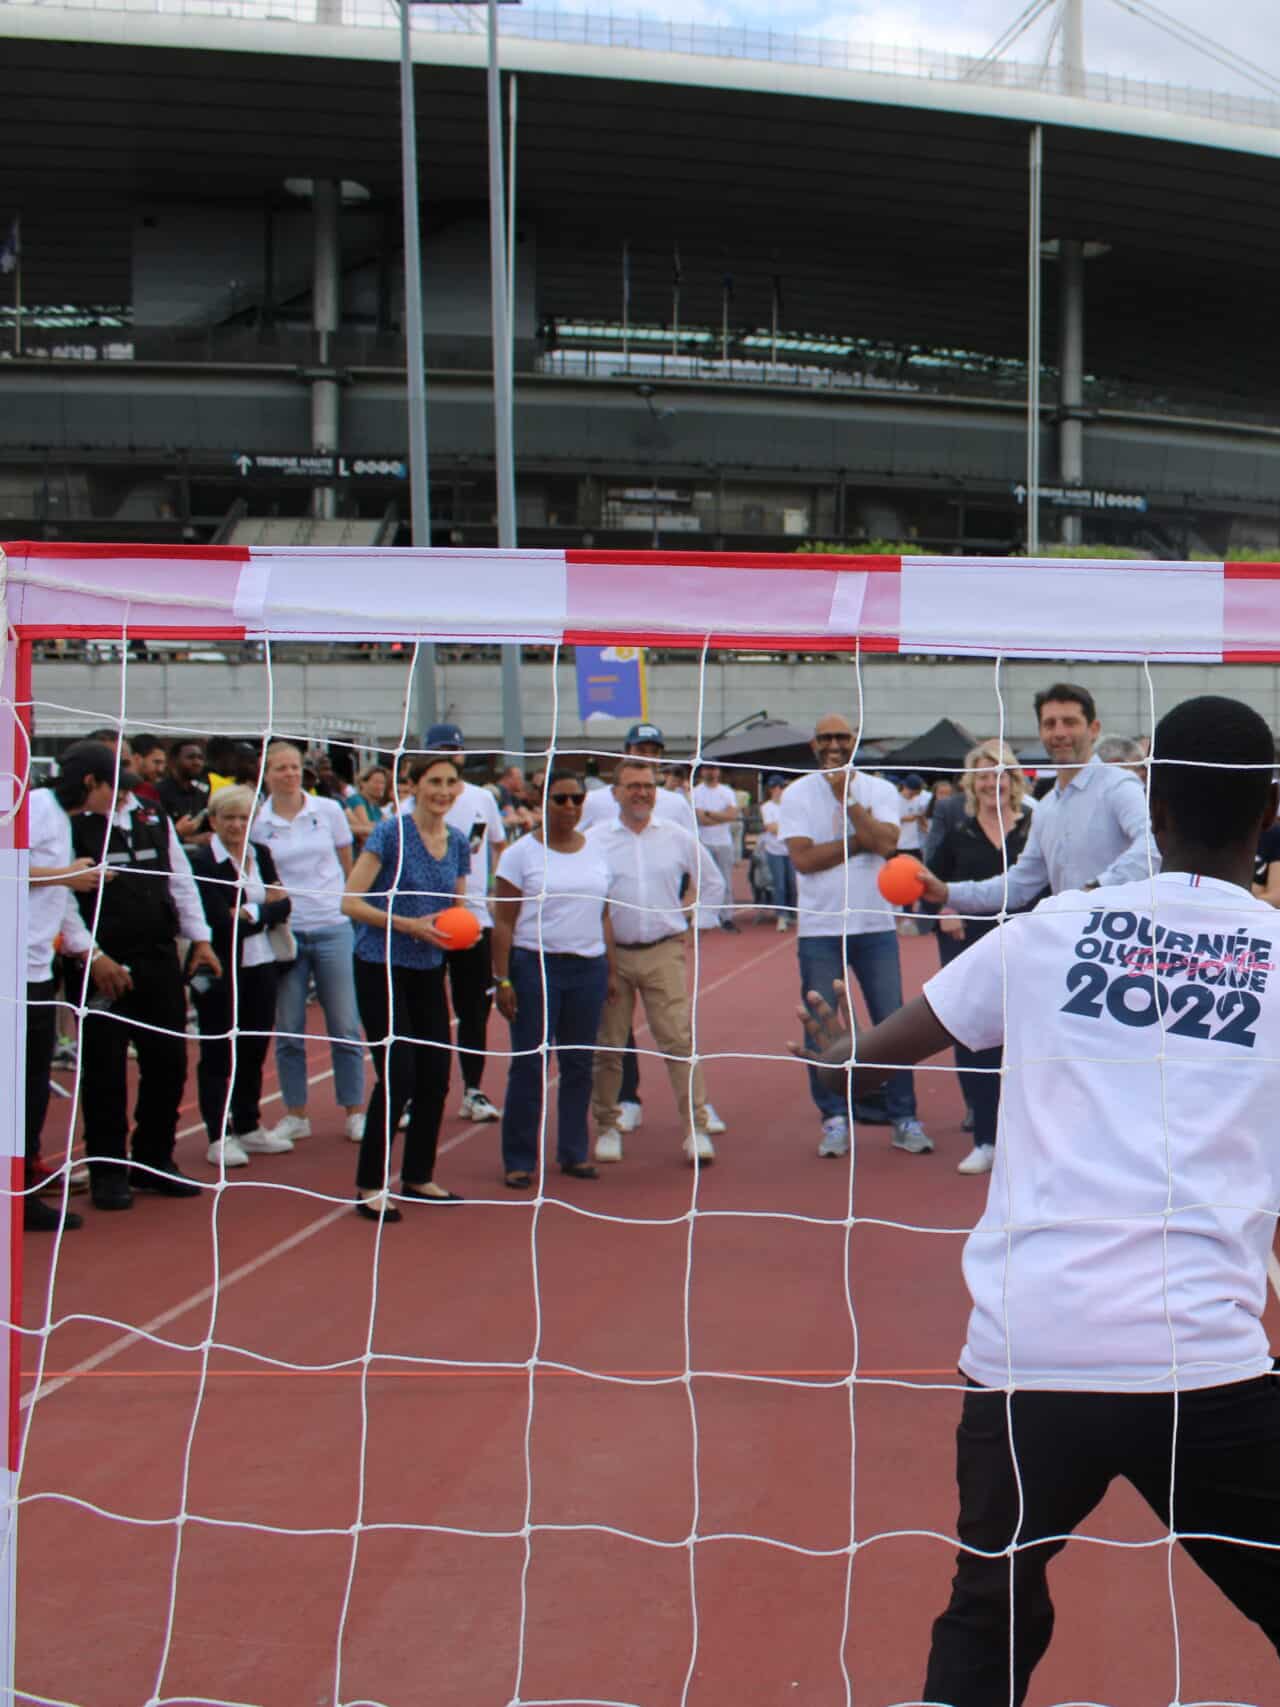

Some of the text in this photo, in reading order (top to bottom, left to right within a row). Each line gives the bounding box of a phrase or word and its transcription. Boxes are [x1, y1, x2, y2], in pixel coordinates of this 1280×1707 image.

[1082, 907, 1272, 963] JOURNÉE
[1074, 937, 1268, 994] OLYMPIQUE
[1060, 962, 1261, 1048] 2022
